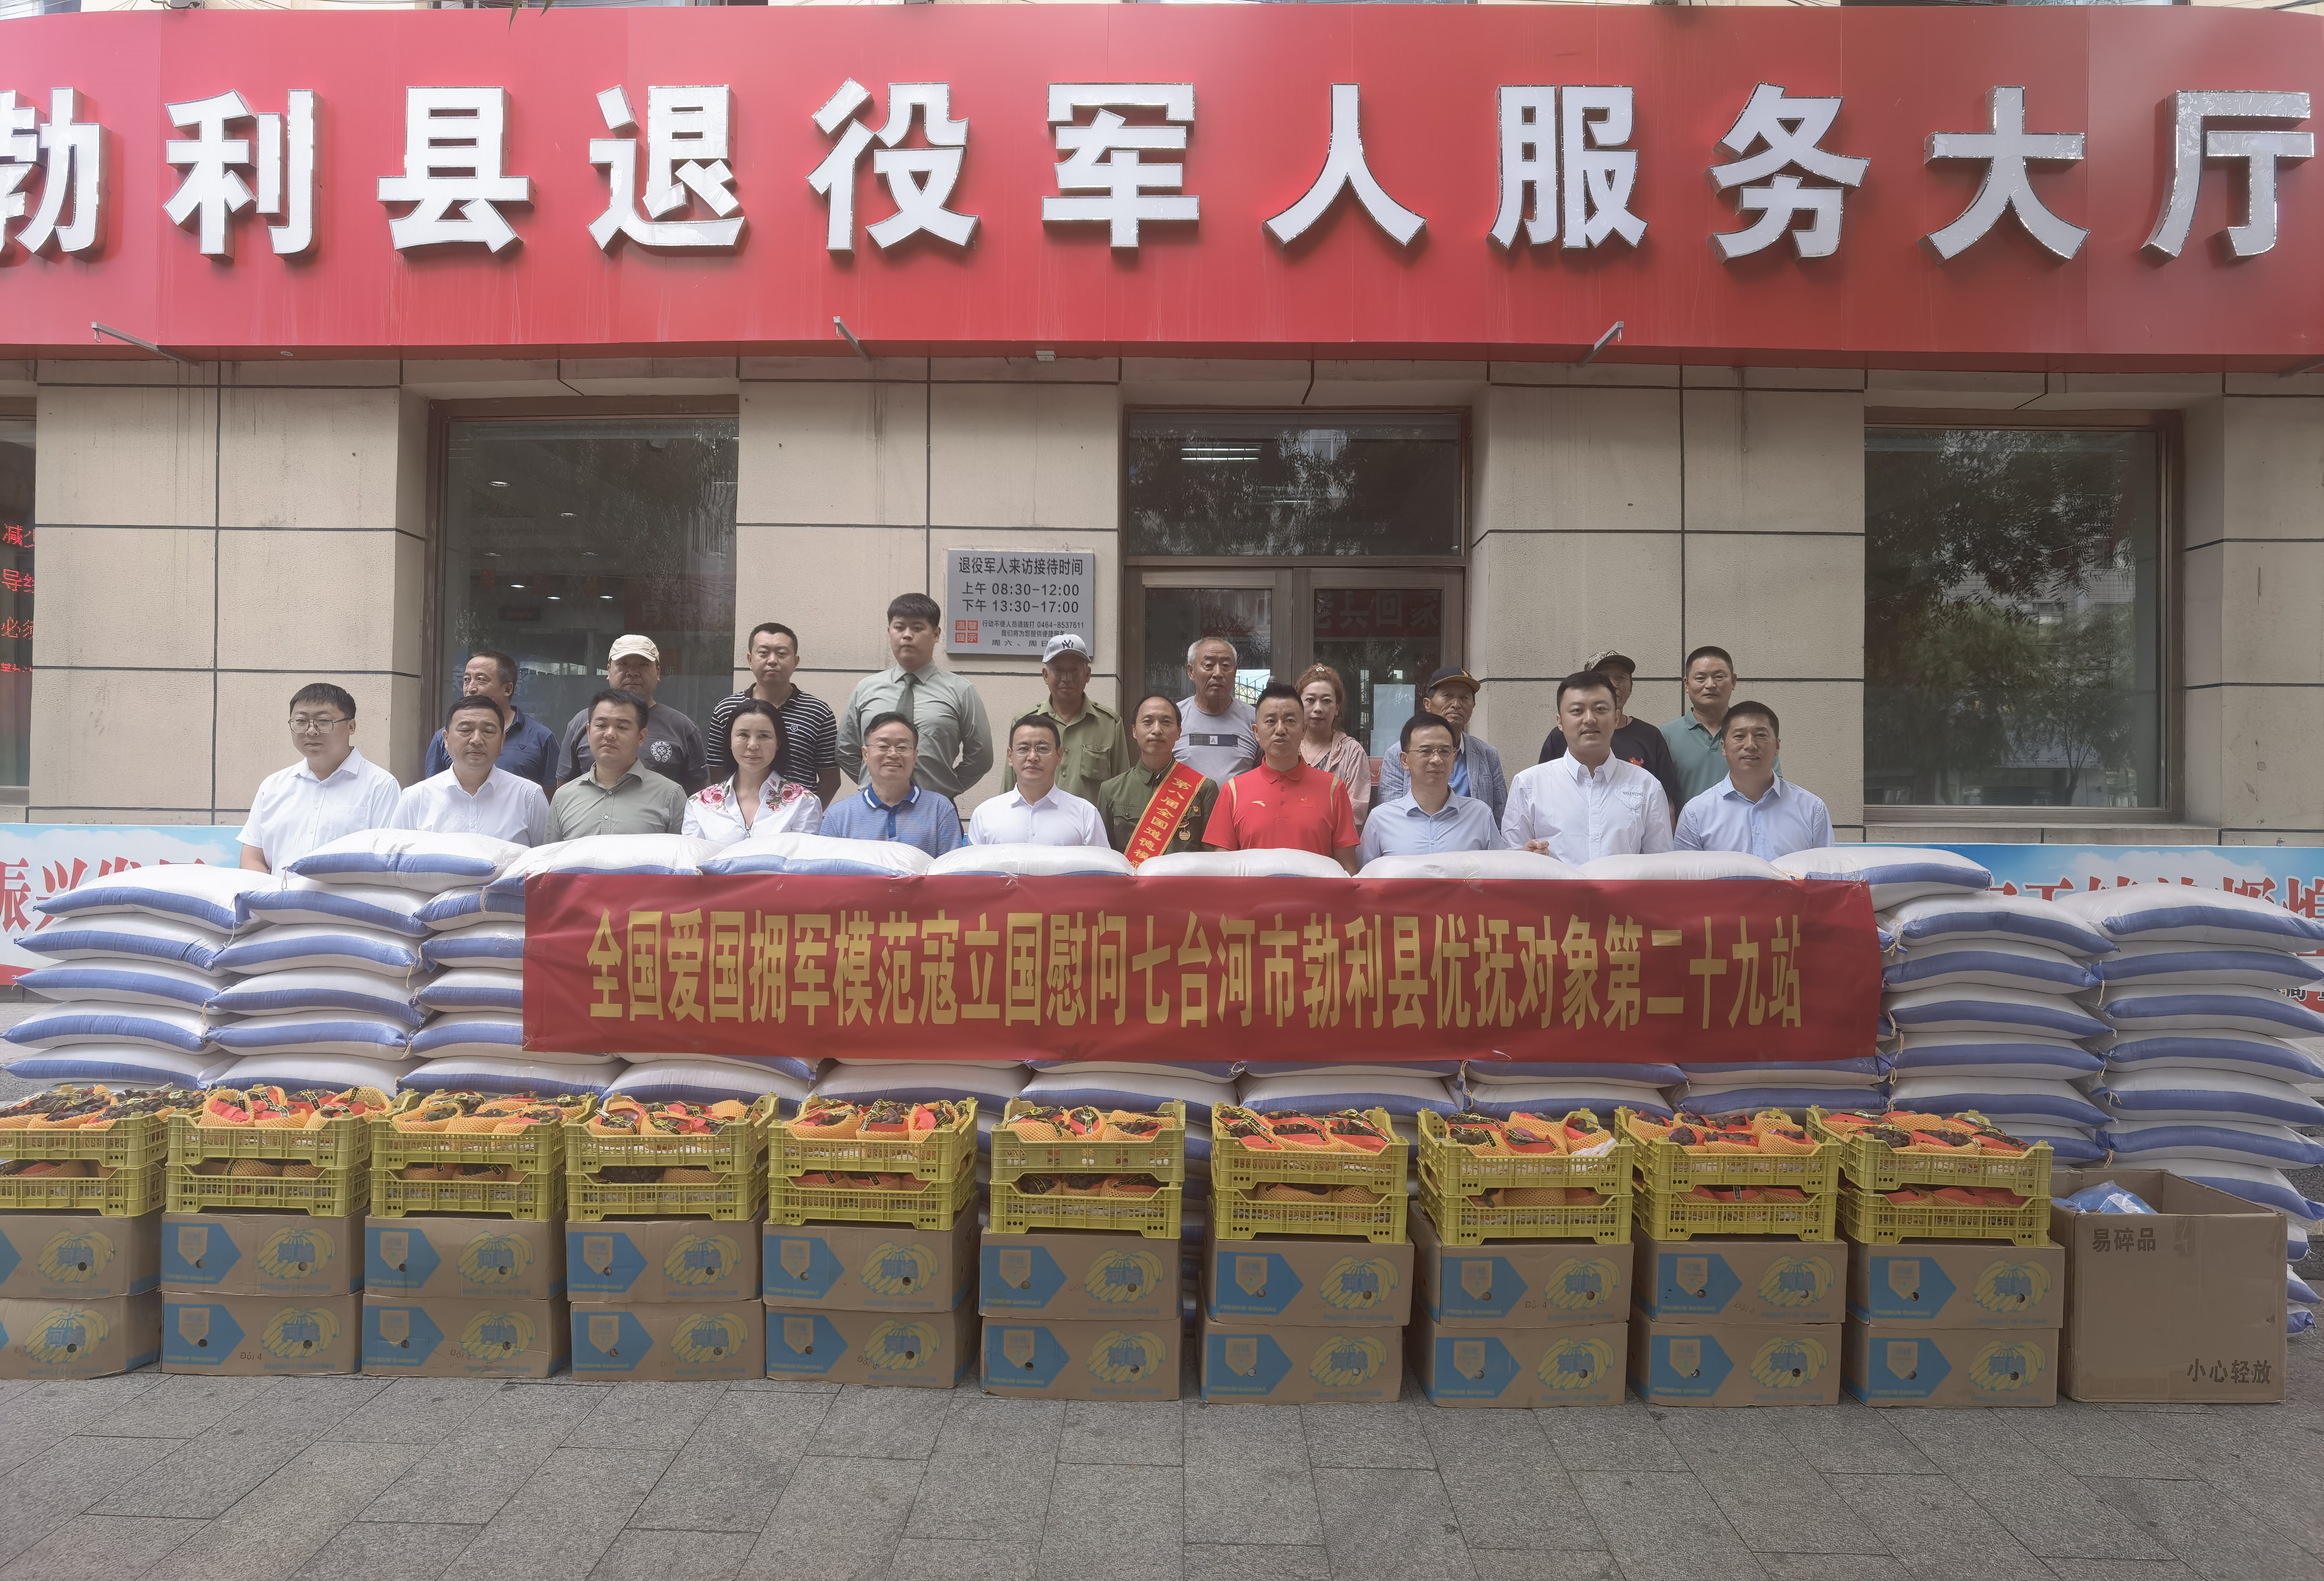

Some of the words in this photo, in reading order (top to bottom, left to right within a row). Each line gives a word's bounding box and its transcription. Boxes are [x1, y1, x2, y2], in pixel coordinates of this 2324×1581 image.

[0, 77, 2315, 263] 勃利县退役军人服务大厅
[958, 556, 1083, 576] 退役军人来访接待时间
[962, 581, 987, 595] 上午
[992, 583, 1079, 596] 08:30-12:00
[962, 599, 987, 612] 下午
[992, 601, 1079, 613] 13:30-17:00
[2092, 1227, 2156, 1252] 易碎品
[2187, 1358, 2272, 1384] 小心轻放
